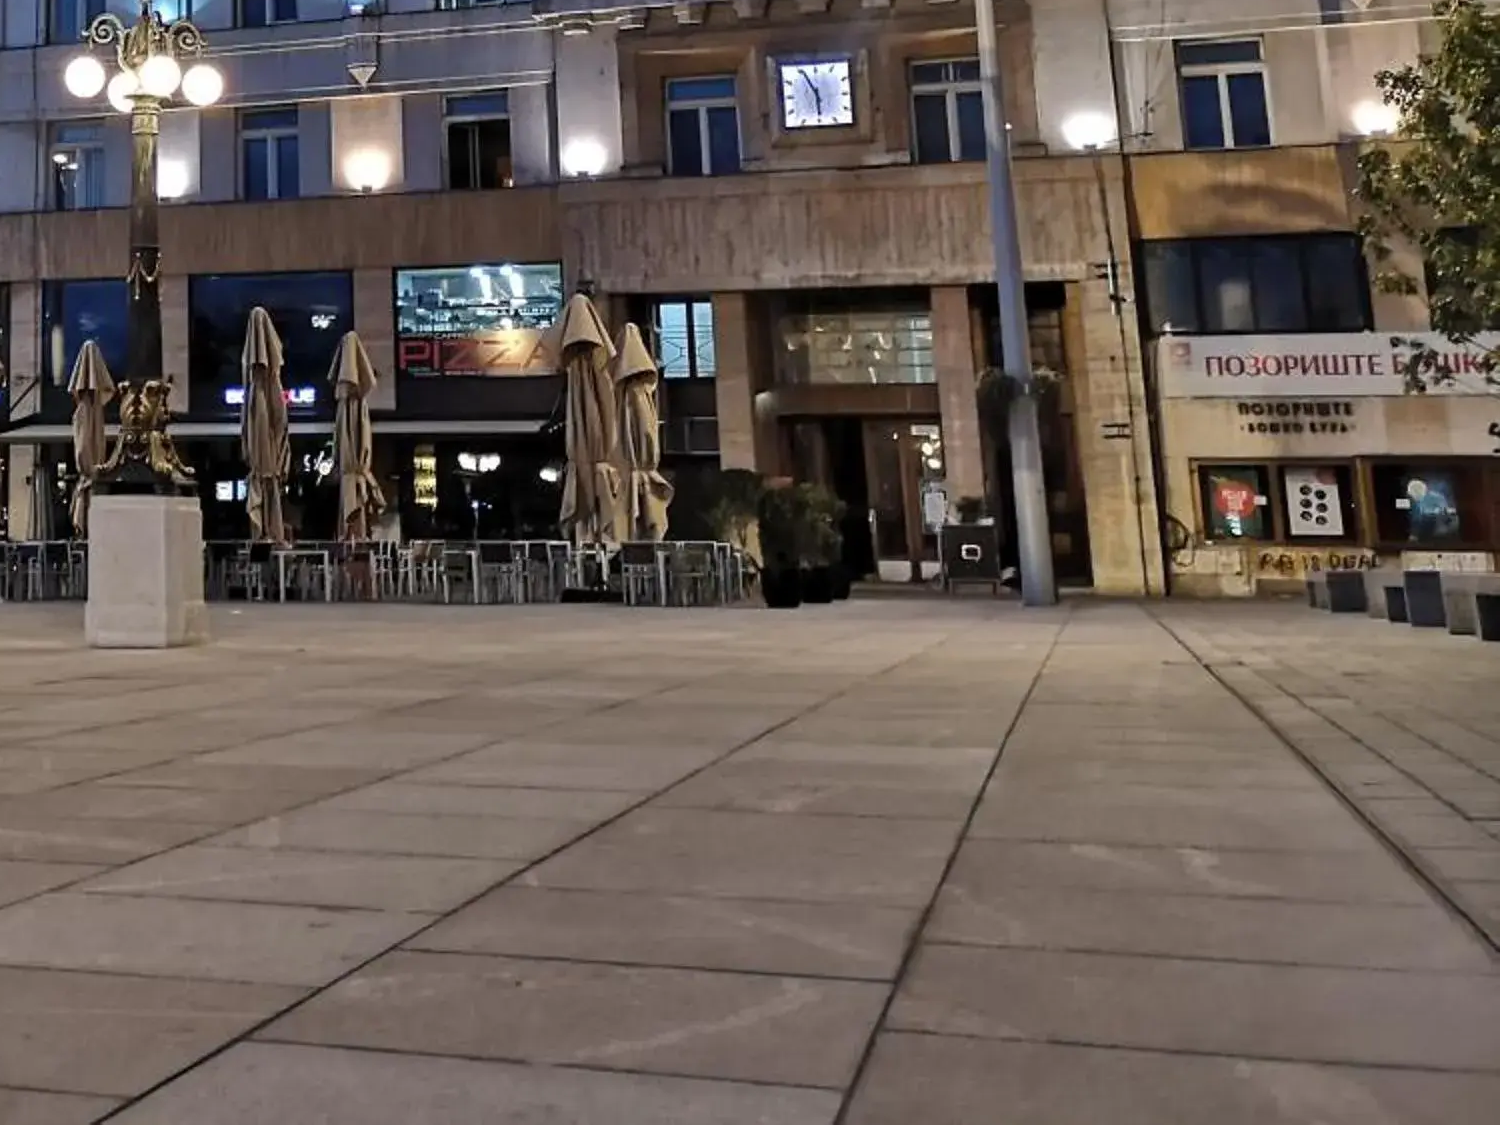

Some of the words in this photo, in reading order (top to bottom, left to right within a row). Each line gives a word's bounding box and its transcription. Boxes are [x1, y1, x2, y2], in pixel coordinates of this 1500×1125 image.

[398, 339, 553, 371] PIZZA
[1204, 352, 1384, 379] ПОЗОРИШТЕ
[1236, 402, 1354, 417] ПОЗОРИШТЕ
